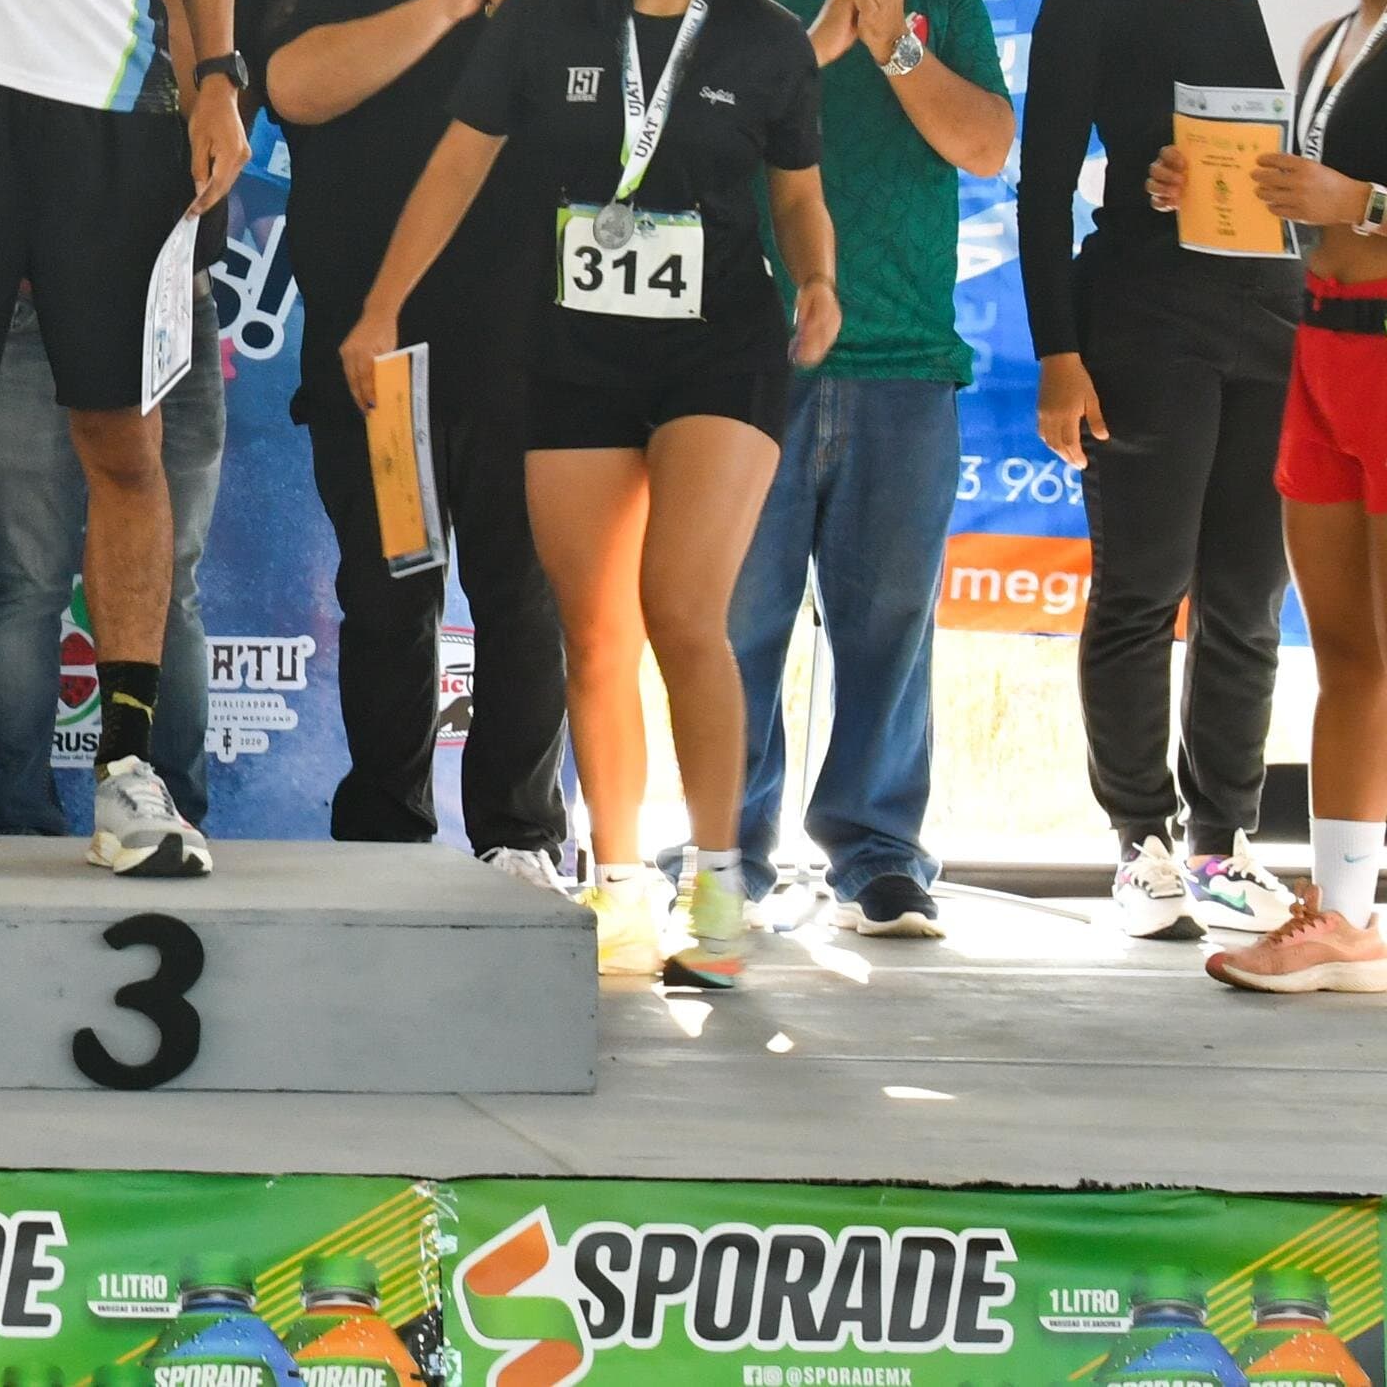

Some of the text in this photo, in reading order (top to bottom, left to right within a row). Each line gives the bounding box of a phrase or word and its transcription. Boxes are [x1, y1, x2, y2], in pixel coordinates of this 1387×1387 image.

[628, 77, 642, 117] UJAT
[634, 116, 658, 159] UJAT
[572, 245, 687, 299] 314
[949, 566, 1093, 616] meg
[71, 911, 206, 1091] 3
[110, 1273, 169, 1301] LITRO
[575, 1232, 1013, 1343] SPORADE
[1061, 1288, 1120, 1315] LITRO
[154, 1364, 263, 1387] SPORADE
[786, 1364, 913, 1387] @SPORADEMX
